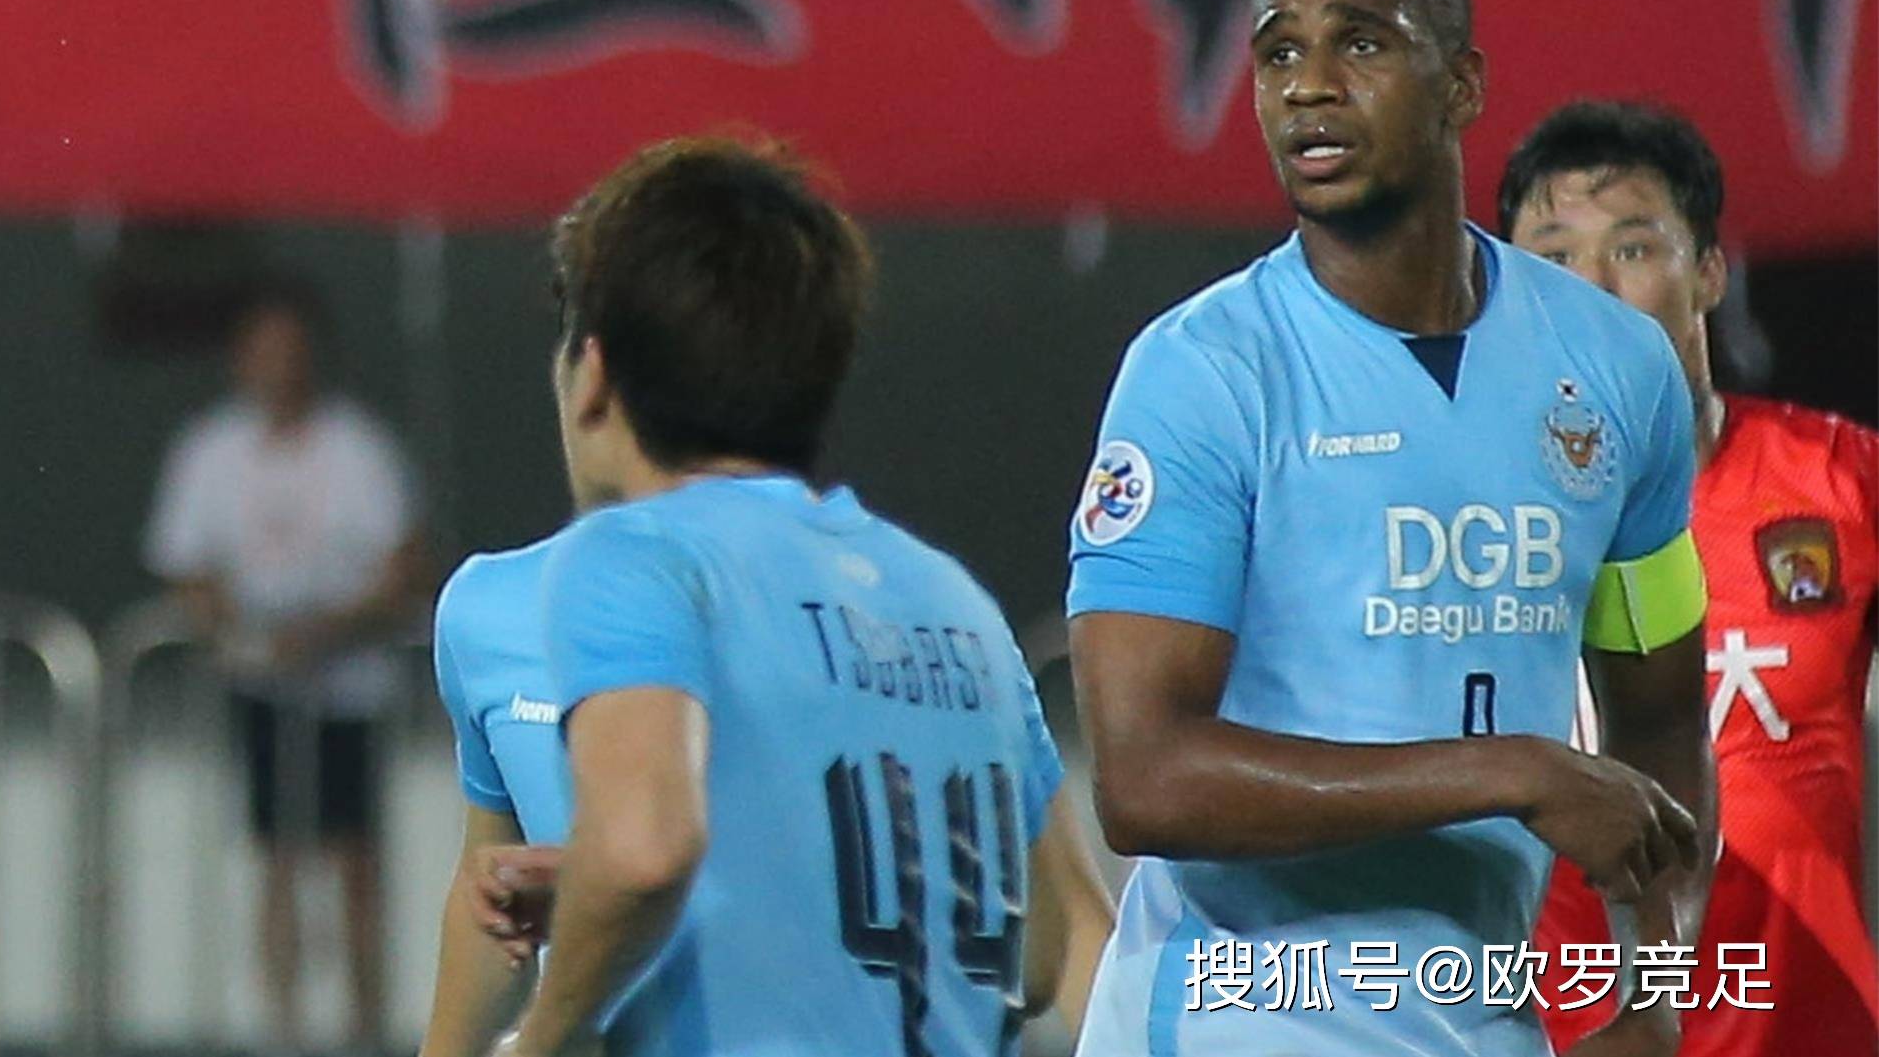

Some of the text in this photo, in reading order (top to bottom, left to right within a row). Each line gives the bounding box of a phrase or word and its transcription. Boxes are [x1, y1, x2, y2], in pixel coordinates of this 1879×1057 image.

[1385, 503, 1565, 590] DGB
[1364, 594, 1570, 644] Daegu Bank
[1706, 626, 1790, 744] 大
[824, 749, 1027, 1057] 44
